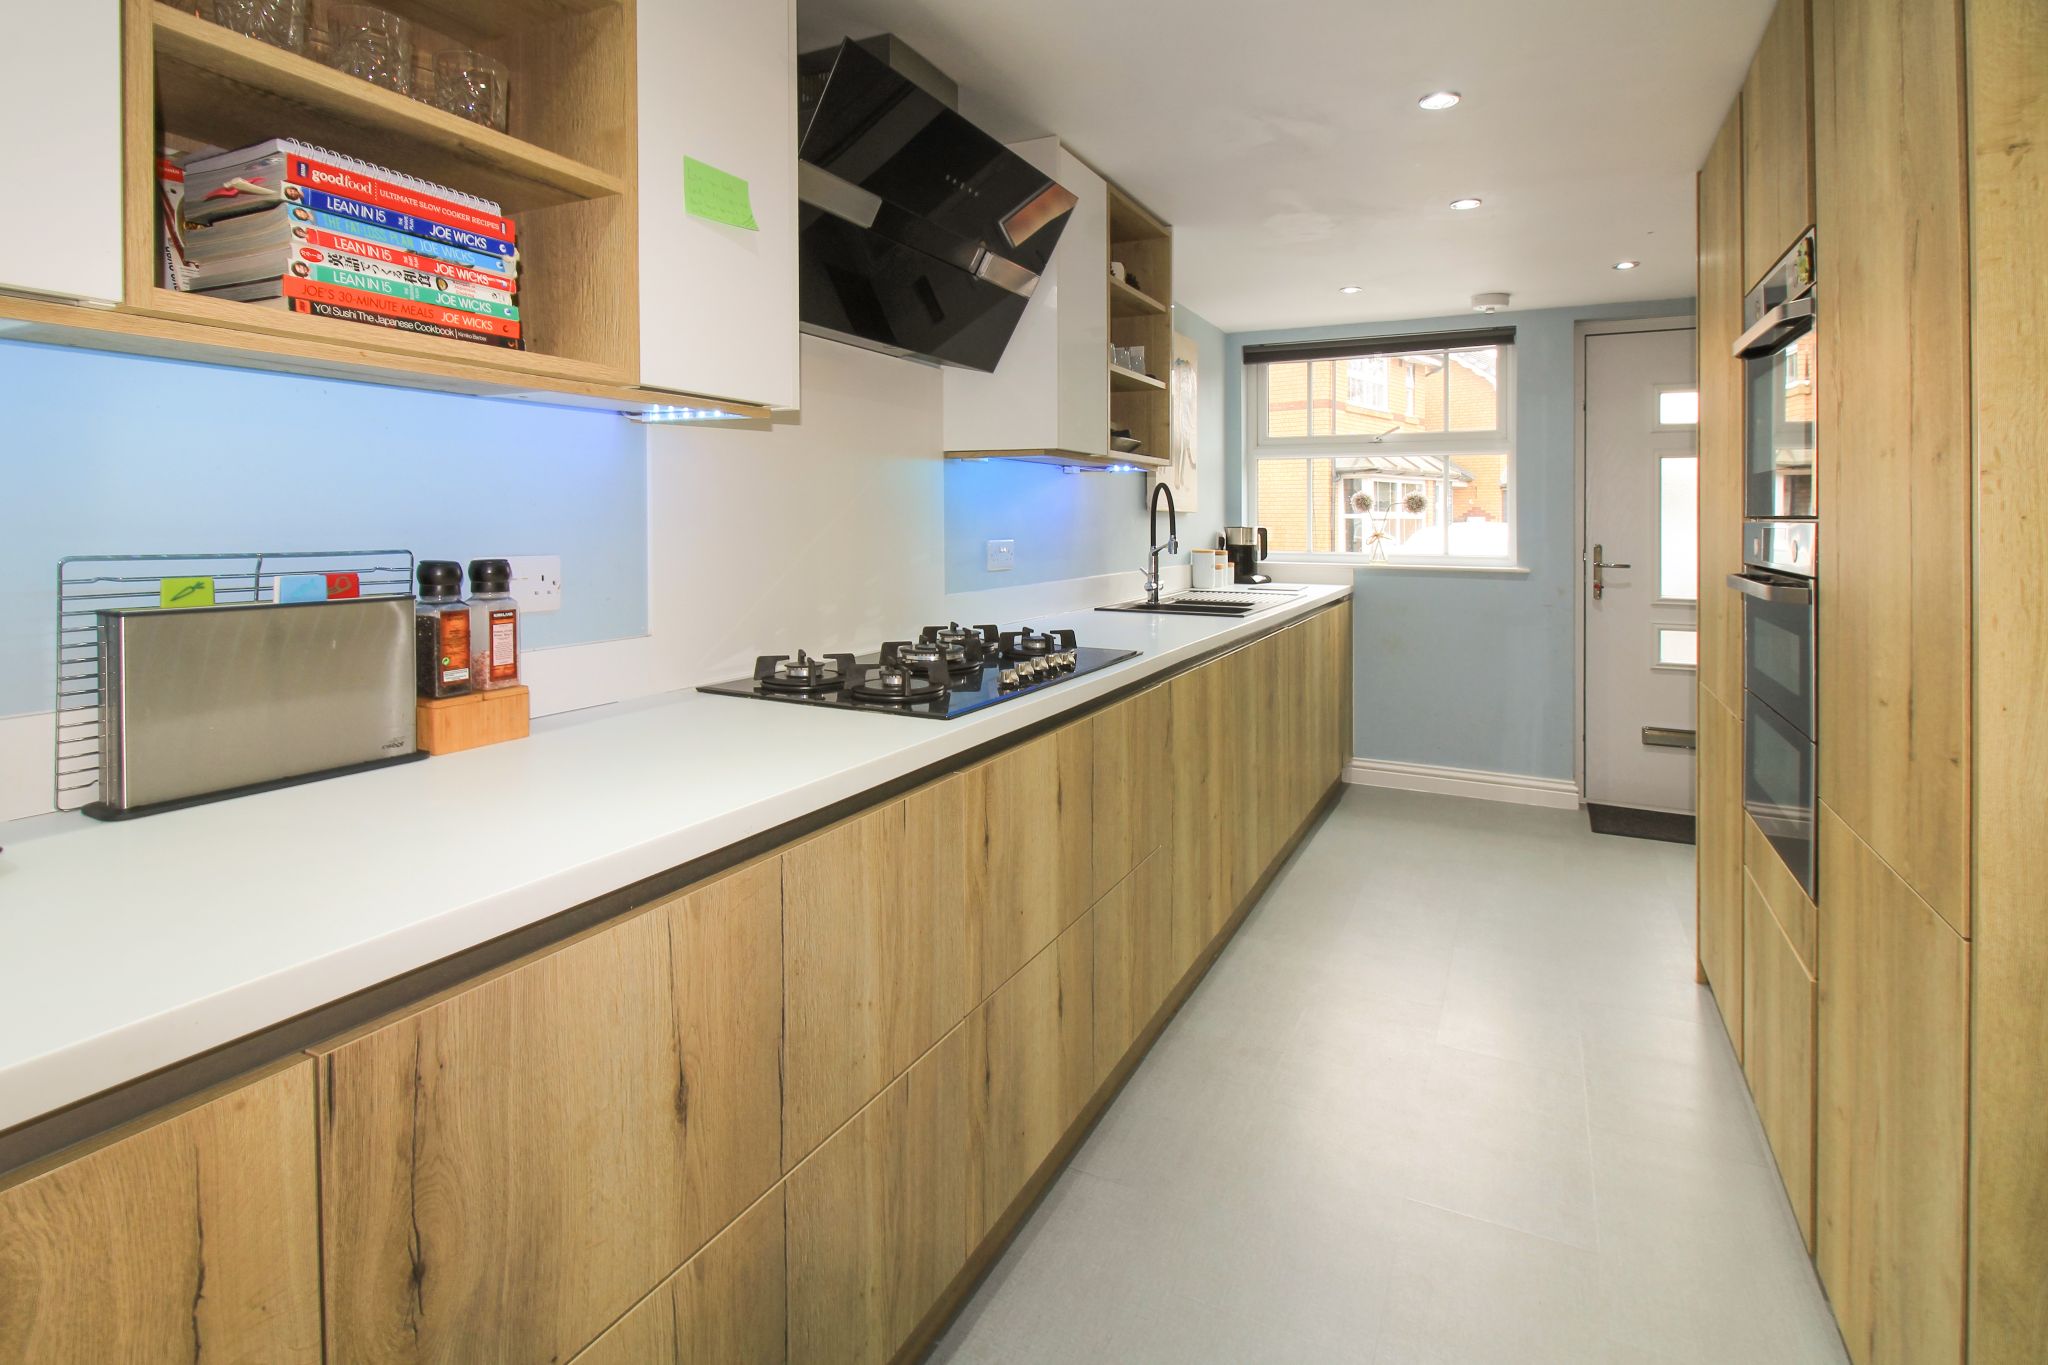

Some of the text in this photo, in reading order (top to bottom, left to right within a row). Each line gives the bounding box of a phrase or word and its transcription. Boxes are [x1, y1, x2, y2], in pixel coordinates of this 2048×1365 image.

[327, 196, 387, 223] LEAN IN 15
[379, 190, 499, 230] ULTIMATE SLOW COOKER RECIPES
[390, 231, 414, 247] PLAN
[430, 224, 488, 249] JOE WICKS
[334, 237, 393, 263] LEAN IN 15
[420, 240, 475, 263] JOE WICKS
[327, 252, 432, 288] 英語でつくる和食
[333, 271, 392, 293] LEAN IN 15
[434, 262, 489, 285] JOE WICKS
[302, 284, 335, 300] JOE'S
[400, 303, 434, 319] MEALS
[435, 293, 492, 313] JOE WICKS
[313, 302, 455, 337] YO! Sushi The Japanese Cookbook
[441, 312, 493, 331] JOE WICKS
